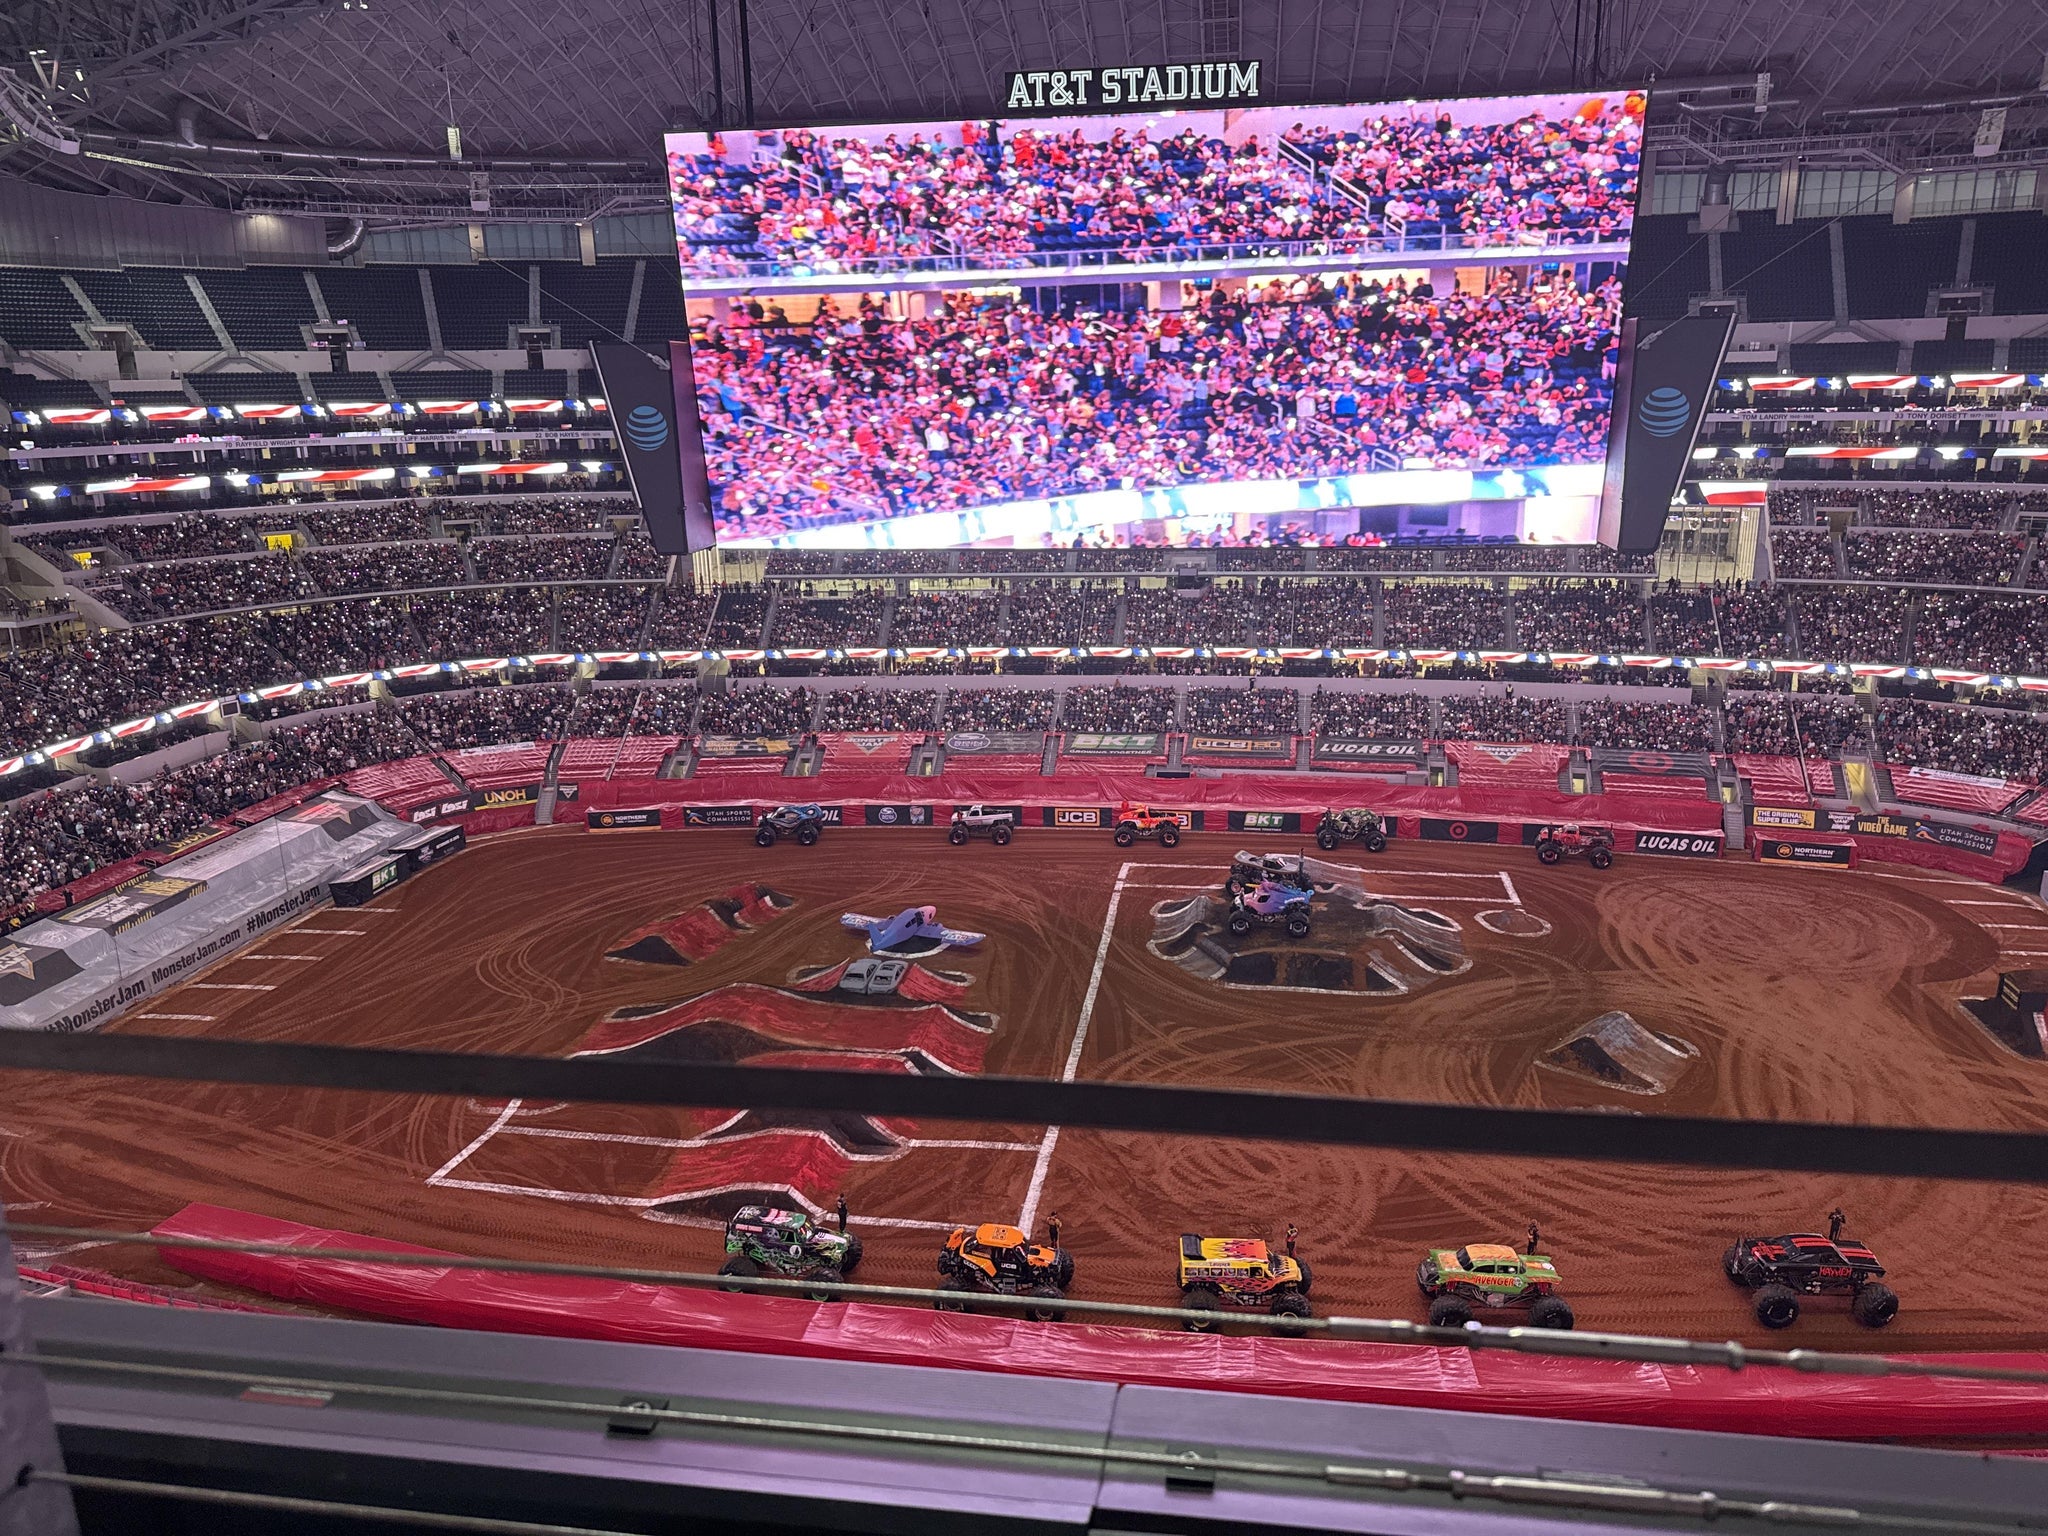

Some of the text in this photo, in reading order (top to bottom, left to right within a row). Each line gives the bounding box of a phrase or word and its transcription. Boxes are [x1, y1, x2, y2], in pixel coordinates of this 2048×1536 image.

[1008, 62, 1259, 108] AT&T STADIUM
[1071, 733, 1157, 749] BKT
[1197, 740, 1247, 748] JCB
[1319, 743, 1417, 756] LUCAS OIL
[484, 788, 526, 803] UNOH
[1058, 811, 1097, 823] JCB
[1245, 814, 1283, 826] BKT
[1771, 811, 1803, 819] ORIGINAL
[1781, 817, 1800, 825] GLUE
[1877, 816, 1890, 825] THE
[1858, 821, 1882, 833] VIDEO
[1883, 824, 1908, 836] GAME
[1638, 835, 1717, 853] LUCAS OIL
[1939, 835, 1992, 851] COMMISSION
[1940, 828, 1995, 845] UTAH SPORTS
[1795, 847, 1834, 856] NORTHERN
[372, 864, 397, 888] BKT
[247, 884, 320, 933] #MonsterJam
[151, 927, 241, 985] MonsterJam.com
[1475, 1275, 1514, 1287] AVENGER
